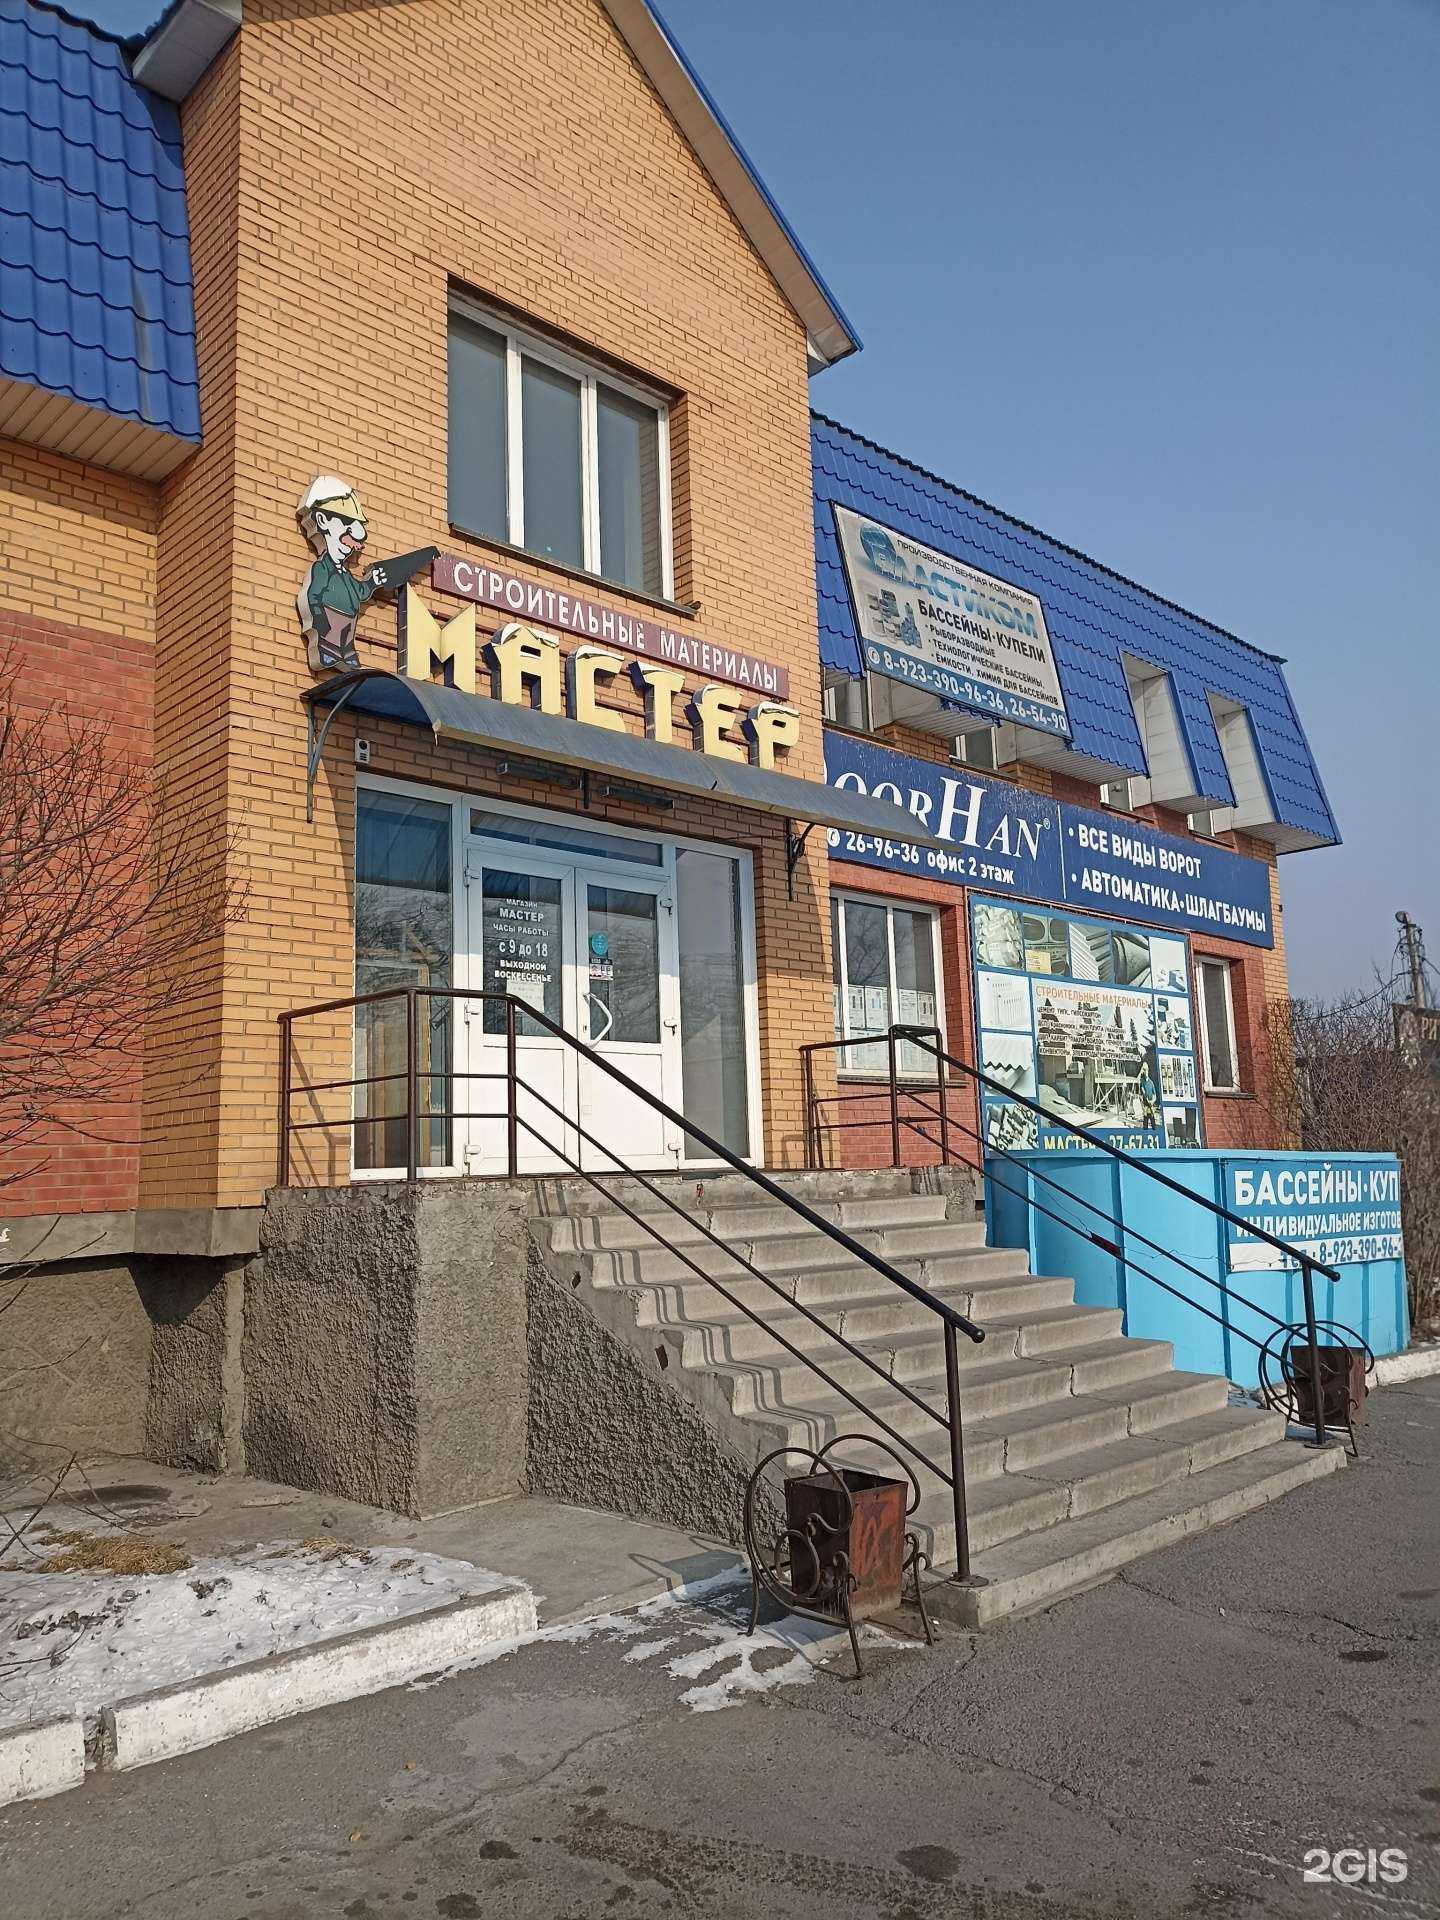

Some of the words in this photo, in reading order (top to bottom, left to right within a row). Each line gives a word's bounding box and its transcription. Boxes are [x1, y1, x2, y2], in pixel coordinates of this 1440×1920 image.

[897, 539, 988, 586] ПРОИЗВОДСТВЕННАЯ
[988, 578, 1033, 606] КОМПАНИЯ
[453, 561, 646, 650] СТРОИТЕЛЬНЫЕ
[660, 630, 778, 692] МАТЕРИАЛЫ
[930, 623, 996, 658] РЫБОРАЗВОДНЫЕ
[933, 638, 1004, 673] ТЕХНОЛОГИЧЕСКИЕ
[403, 582, 800, 769] МАСТЕР
[976, 668, 1003, 685] ХИМИЯ
[1003, 677, 1018, 691] ДЛЯ
[1018, 682, 1059, 706] БАССЕЙНОВ
[1010, 697, 1067, 731] 26-54-90
[846, 831, 920, 865] 26-96-36
[927, 849, 965, 875] офис
[968, 858, 978, 877] 2
[980, 863, 1015, 885] этаж
[1078, 824, 1109, 853] ВСЕ
[1111, 833, 1156, 868] ВИДЫ
[1159, 848, 1201, 879] ВОРОТ
[499, 907, 545, 923] МАСТЕР
[506, 898, 538, 908] МАГАЗИН
[493, 923, 516, 933] ЧАСЫ
[500, 959, 547, 972] ВЫХОДНОЙ
[509, 939, 516, 954] 9
[518, 943, 532, 957] до
[535, 942, 548, 957] 18
[494, 970, 552, 983] ВОСКРЕСЕНЬЕ
[1035, 985, 1101, 1003] СТРОИТЕЛЬНЫЕ
[1102, 993, 1148, 1009] МАТЕРИАЛЫ
[1234, 1163, 1362, 1206] БАССЕЙНЫ
